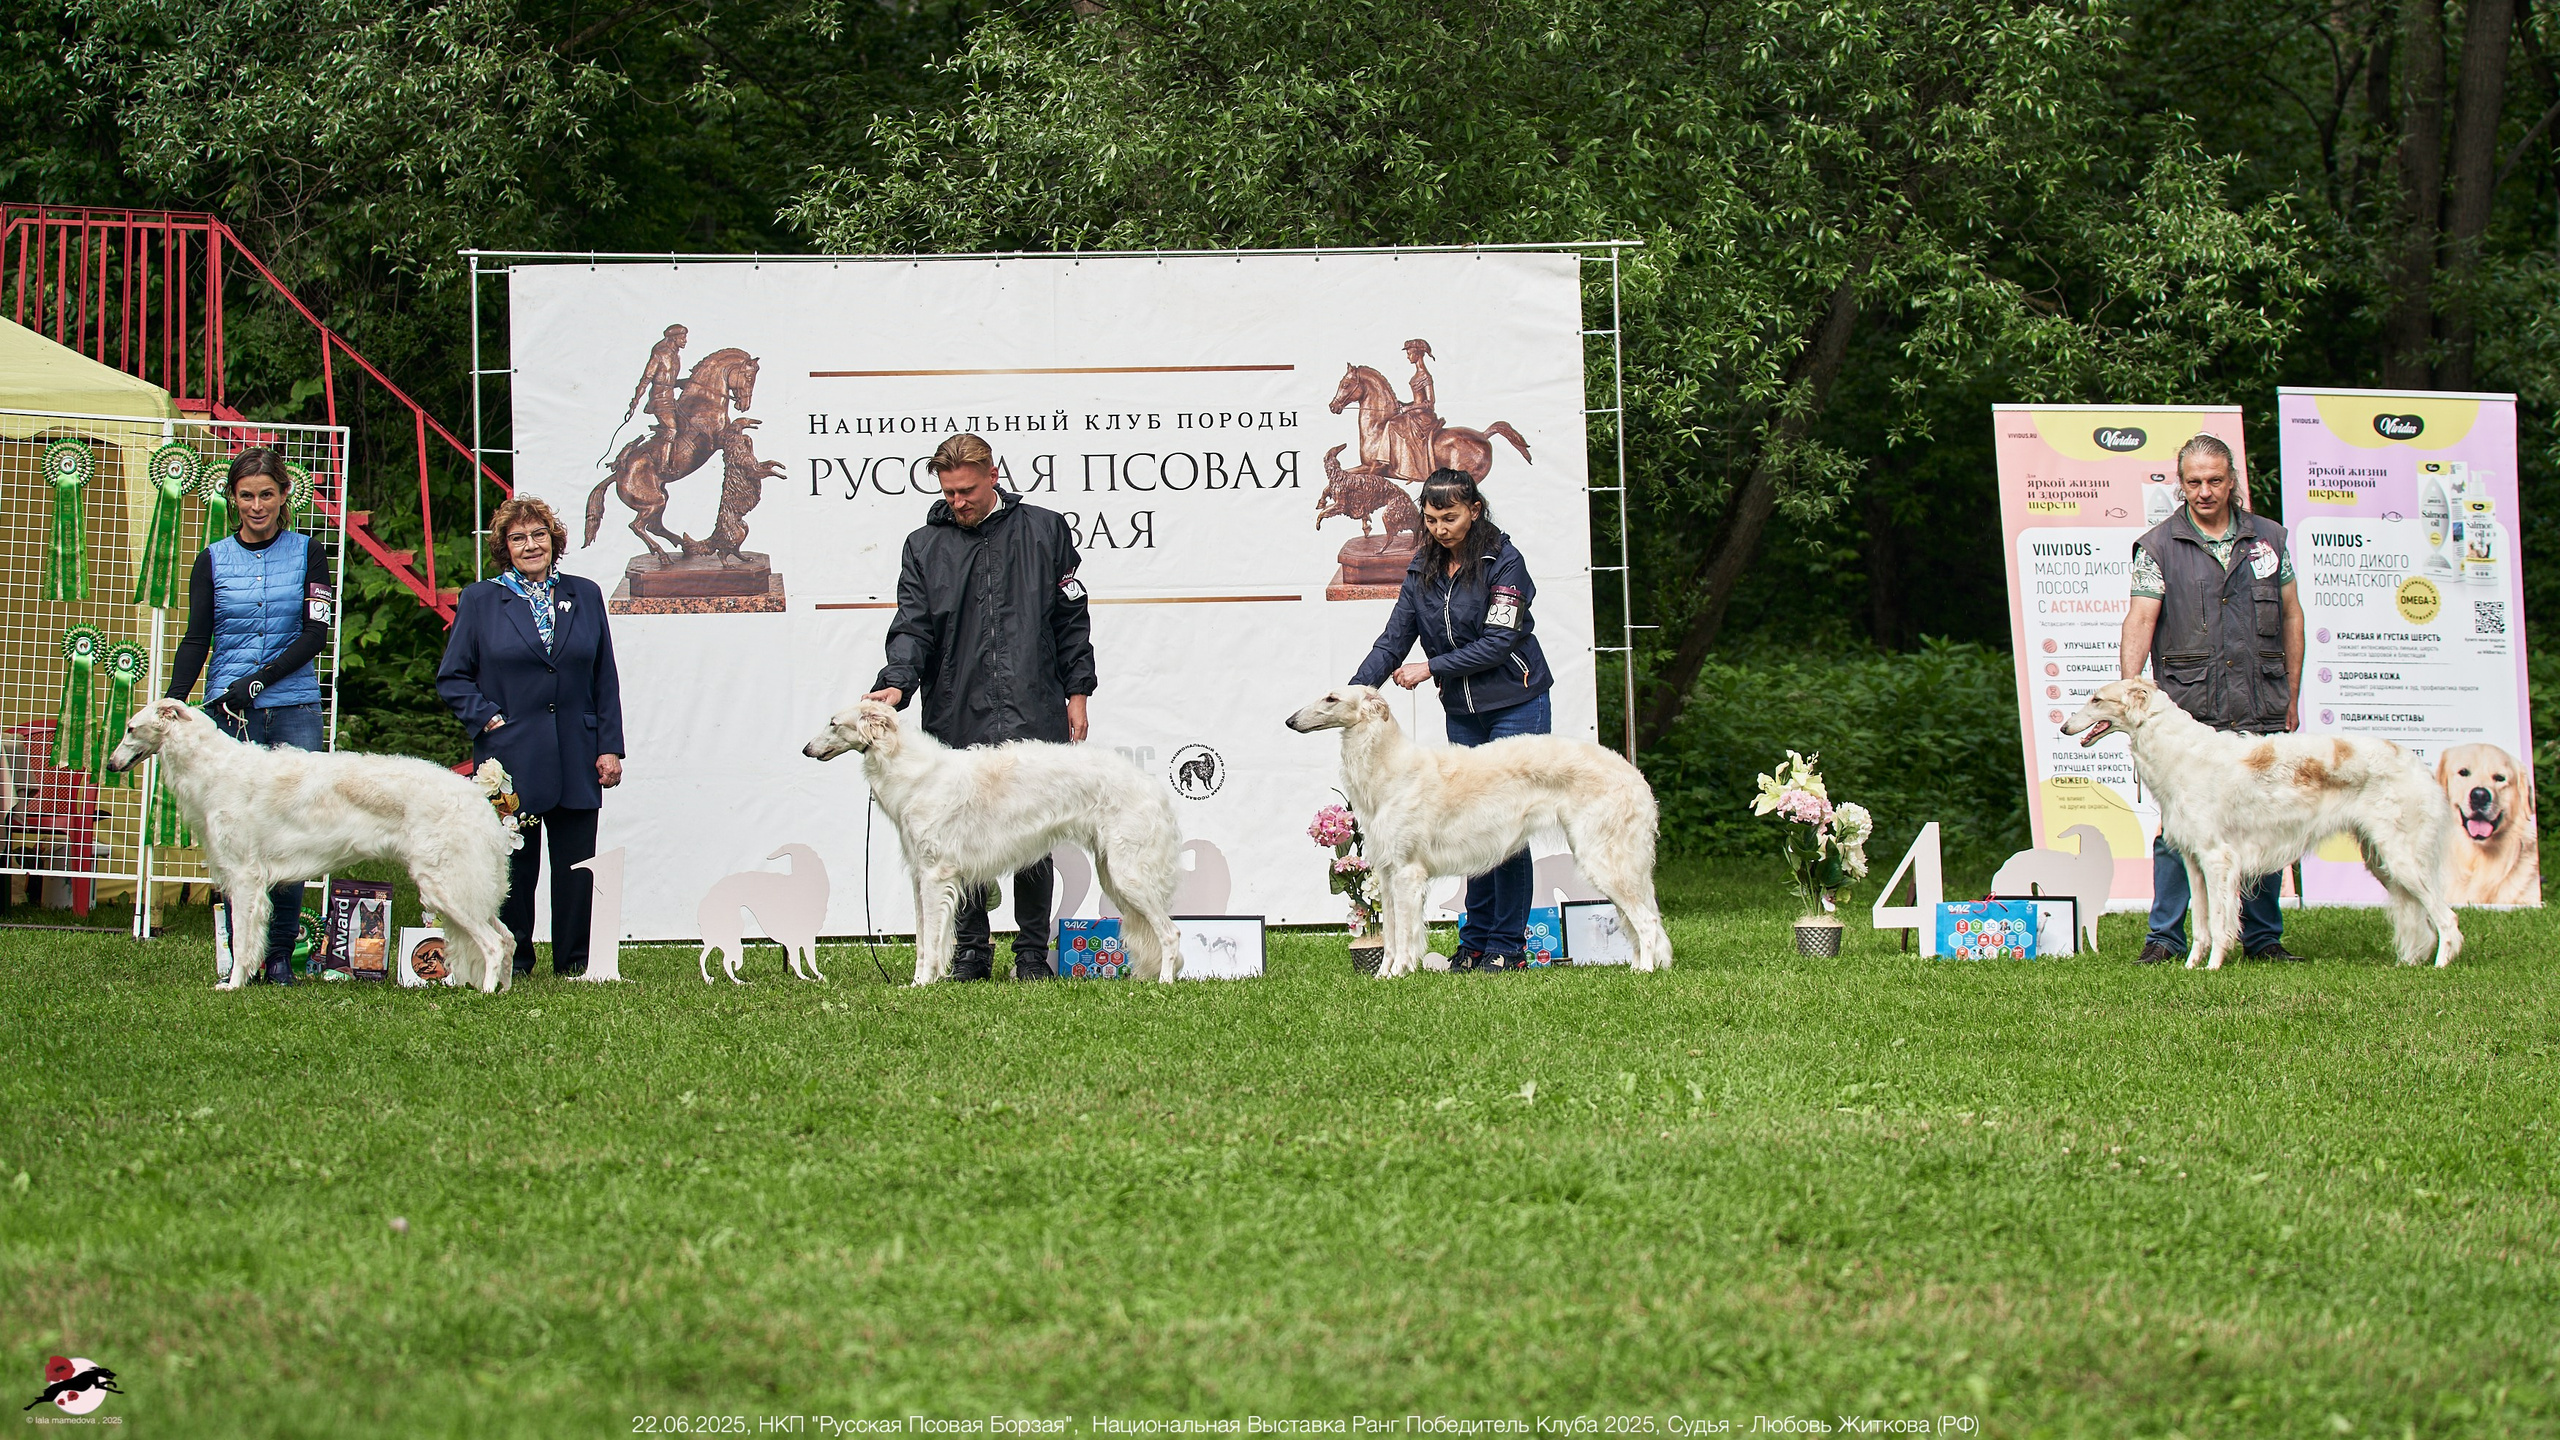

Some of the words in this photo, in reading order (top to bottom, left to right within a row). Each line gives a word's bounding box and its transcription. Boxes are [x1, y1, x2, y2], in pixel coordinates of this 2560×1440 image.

[2380, 416, 2418, 435] Vividus
[2100, 430, 2140, 447] Vividus
[808, 454, 1058, 500] РУССАЯ
[1082, 450, 1301, 493] ПСОВАЯ
[2308, 466, 2345, 477] яркой
[2348, 467, 2388, 477] жизни
[2027, 478, 2066, 489] яркой
[2069, 480, 2110, 488] жизни
[2308, 479, 2316, 487] и
[2320, 477, 2376, 490] здоровой
[2028, 491, 2035, 499] и
[2040, 489, 2098, 501] здоровой
[2309, 489, 2354, 500] шерсти
[2028, 501, 2076, 511] шерсти
[1065, 510, 1156, 551] ЗАЯ
[2312, 533, 2363, 547] VIVIDUS
[2032, 543, 2092, 556] VIIVIDUS
[2313, 553, 2355, 567] МАСЛО
[2359, 554, 2409, 570] ДИКОГО
[2035, 562, 2079, 575] МАСЛО
[2314, 573, 2402, 587] КАМЧАТСКОГО
[2036, 581, 2089, 595] ЛОСОСЯ
[2038, 600, 2047, 613] С
[2051, 599, 2127, 613] АСТАКСАНТ
[2314, 592, 2364, 607] ЛОСОСЯ
[2400, 595, 2437, 605] OMEGA-3
[1487, 604, 1511, 625] 93
[2337, 632, 2374, 641] КРАСИВАЯ
[2376, 633, 2382, 641] И
[2383, 633, 2409, 641] ГУСТАЯ
[2411, 634, 2441, 642] ШЕРСТЬ
[2338, 672, 2377, 680] ЗДОРОВАЯ
[2379, 672, 2400, 680] КОЖА
[2340, 713, 2389, 722] ПОДВИЖНЫЕ
[2391, 714, 2425, 722] СУСТАВЫ
[2053, 751, 2096, 760] ПОЛЕЗНЫЙ
[2053, 764, 2095, 772] УЛУЧШАЕТ
[2097, 764, 2132, 772] ЯРКОСТЬ
[2055, 776, 2089, 784] РЫЖЕГО
[2096, 776, 2126, 784] ОКРАСА
[1872, 821, 1944, 958] 4
[332, 898, 350, 960] Award
